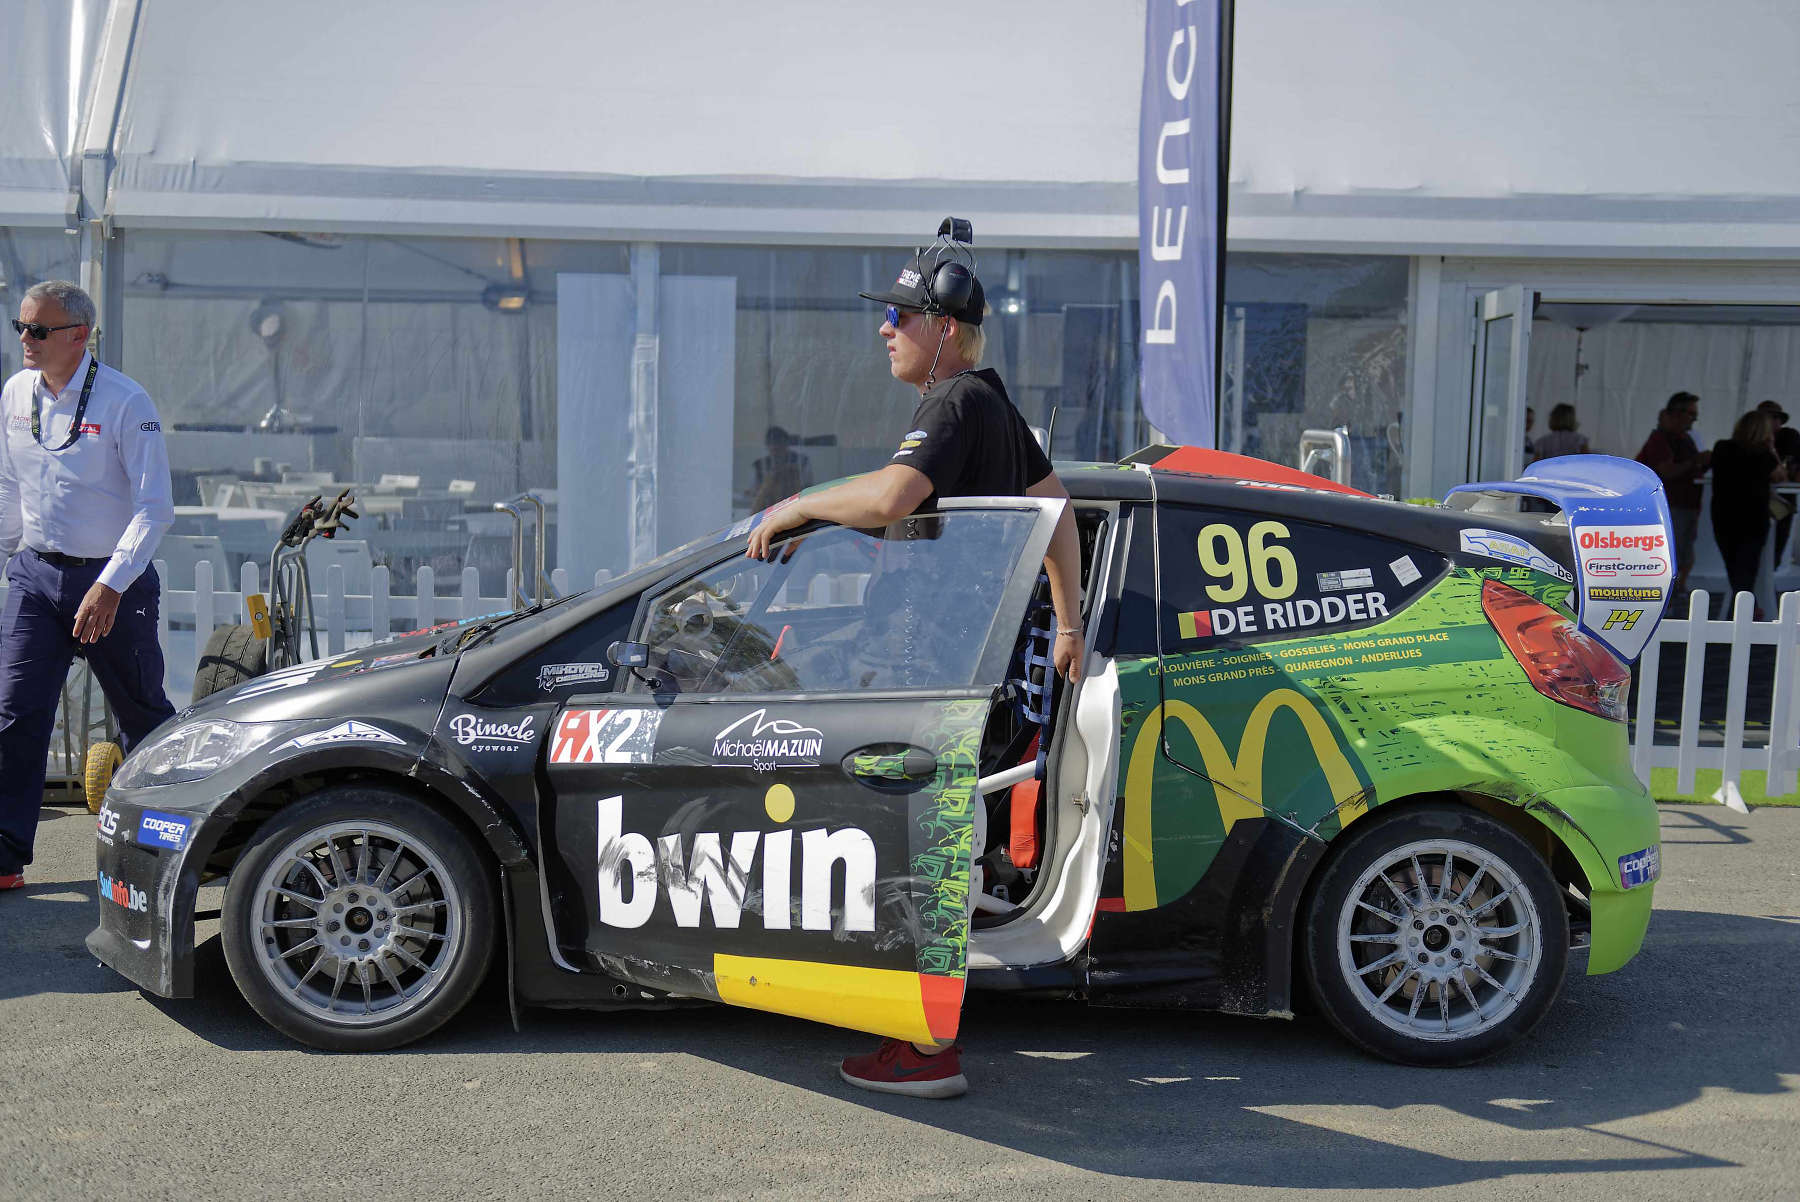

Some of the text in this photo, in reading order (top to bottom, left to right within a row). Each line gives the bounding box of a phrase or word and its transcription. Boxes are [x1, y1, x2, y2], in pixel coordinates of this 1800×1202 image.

[1580, 531, 1665, 551] Olsbergs
[1197, 520, 1299, 604] 96
[1588, 562, 1661, 571] FirstCorner
[1590, 587, 1661, 598] mountune
[1211, 592, 1390, 636] DE RIDDER
[1223, 652, 1273, 666] SOIGNIES
[1280, 644, 1337, 659] GOSSELIES
[1344, 639, 1376, 651] MONS
[1377, 635, 1416, 648] GRAND
[1417, 632, 1450, 643] PLACE
[1173, 675, 1207, 687] MONS
[1208, 670, 1247, 682] GRAND
[1285, 656, 1353, 673] QUAREGNON
[1361, 648, 1423, 664] ANDERLUES
[449, 713, 536, 745] Binocle
[471, 744, 519, 752] eyewear
[753, 758, 777, 774] Sport
[143, 817, 186, 836] COOPER
[159, 831, 182, 843] TIRES
[598, 784, 877, 932] bwin
